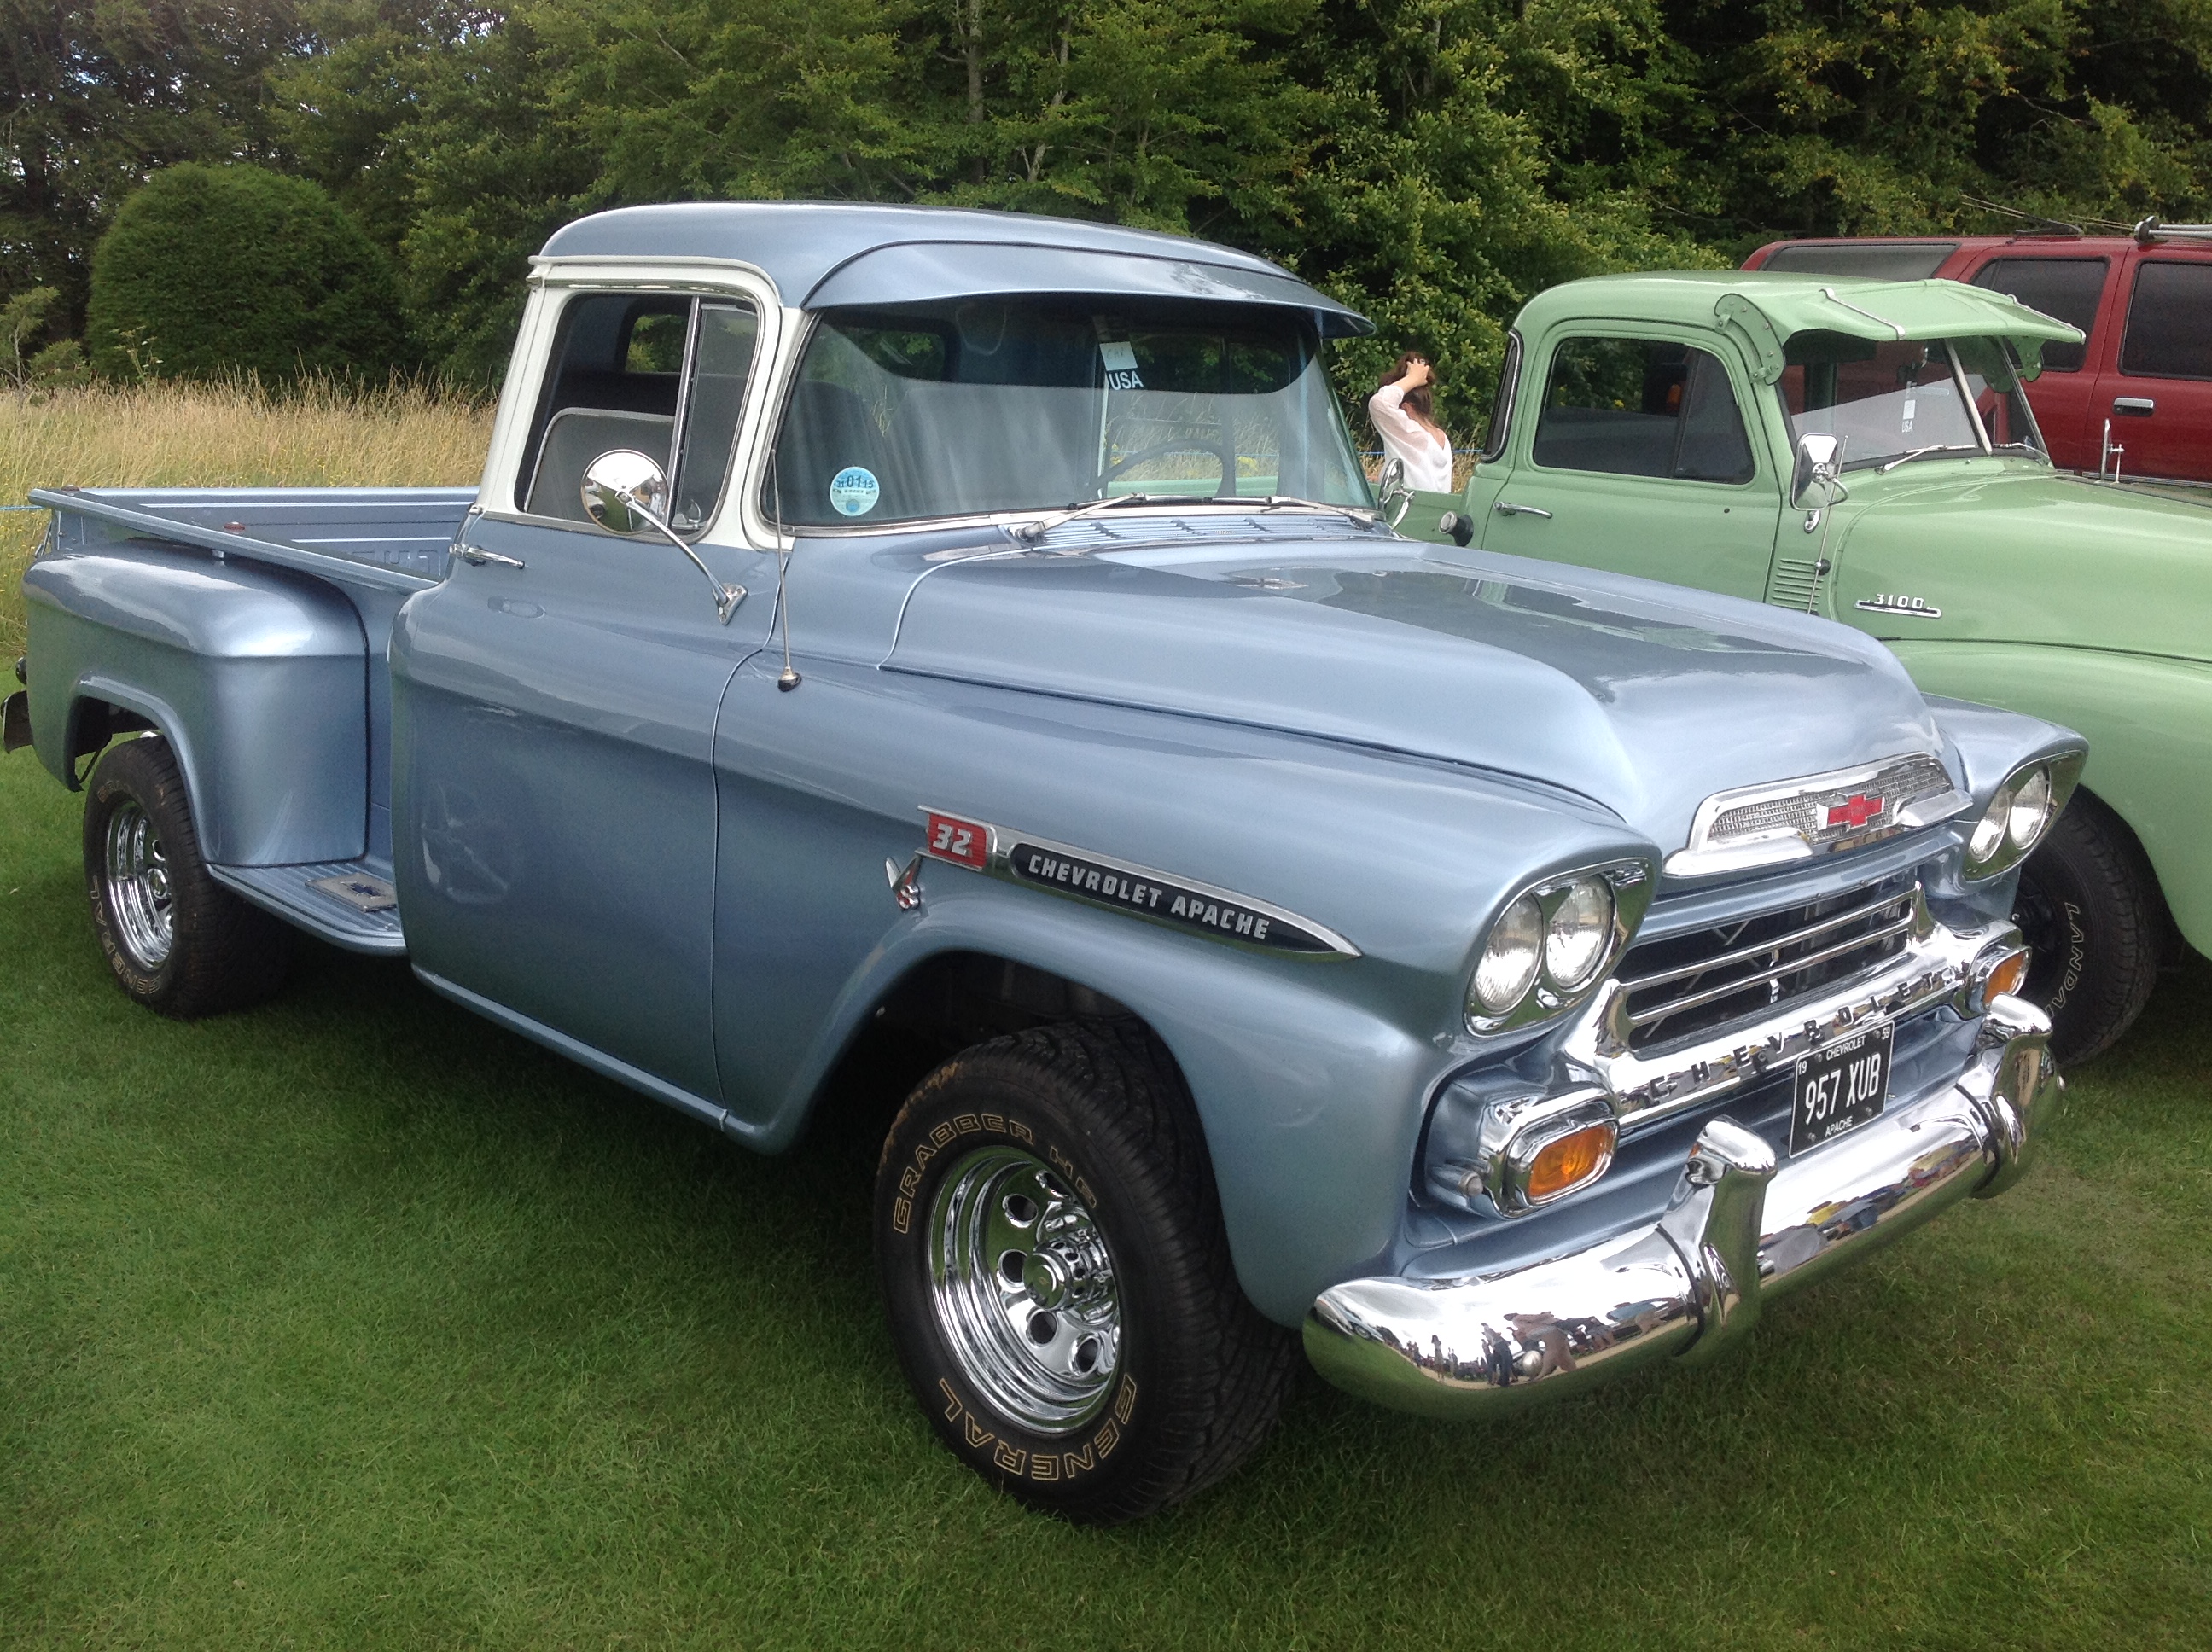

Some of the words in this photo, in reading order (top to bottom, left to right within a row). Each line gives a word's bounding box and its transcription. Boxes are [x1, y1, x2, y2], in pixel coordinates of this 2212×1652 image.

[1109, 370, 1144, 390] USA
[847, 475, 862, 488] 01
[1874, 593, 1924, 609] 3100
[933, 823, 971, 856] 32
[1028, 854, 1162, 907] CHEVROLET
[1171, 896, 1270, 939] APACHE
[1648, 971, 1939, 1101] CHEVROLET
[1825, 1035, 1866, 1061] CHEVROLET
[1798, 1061, 1807, 1075] 19
[1805, 1069, 1842, 1126] 957
[1846, 1052, 1881, 1108] XUB
[1825, 1116, 1854, 1137] APACHE
[894, 1114, 1033, 1234] GRABBER
[939, 1372, 1137, 1480] GENERAL
